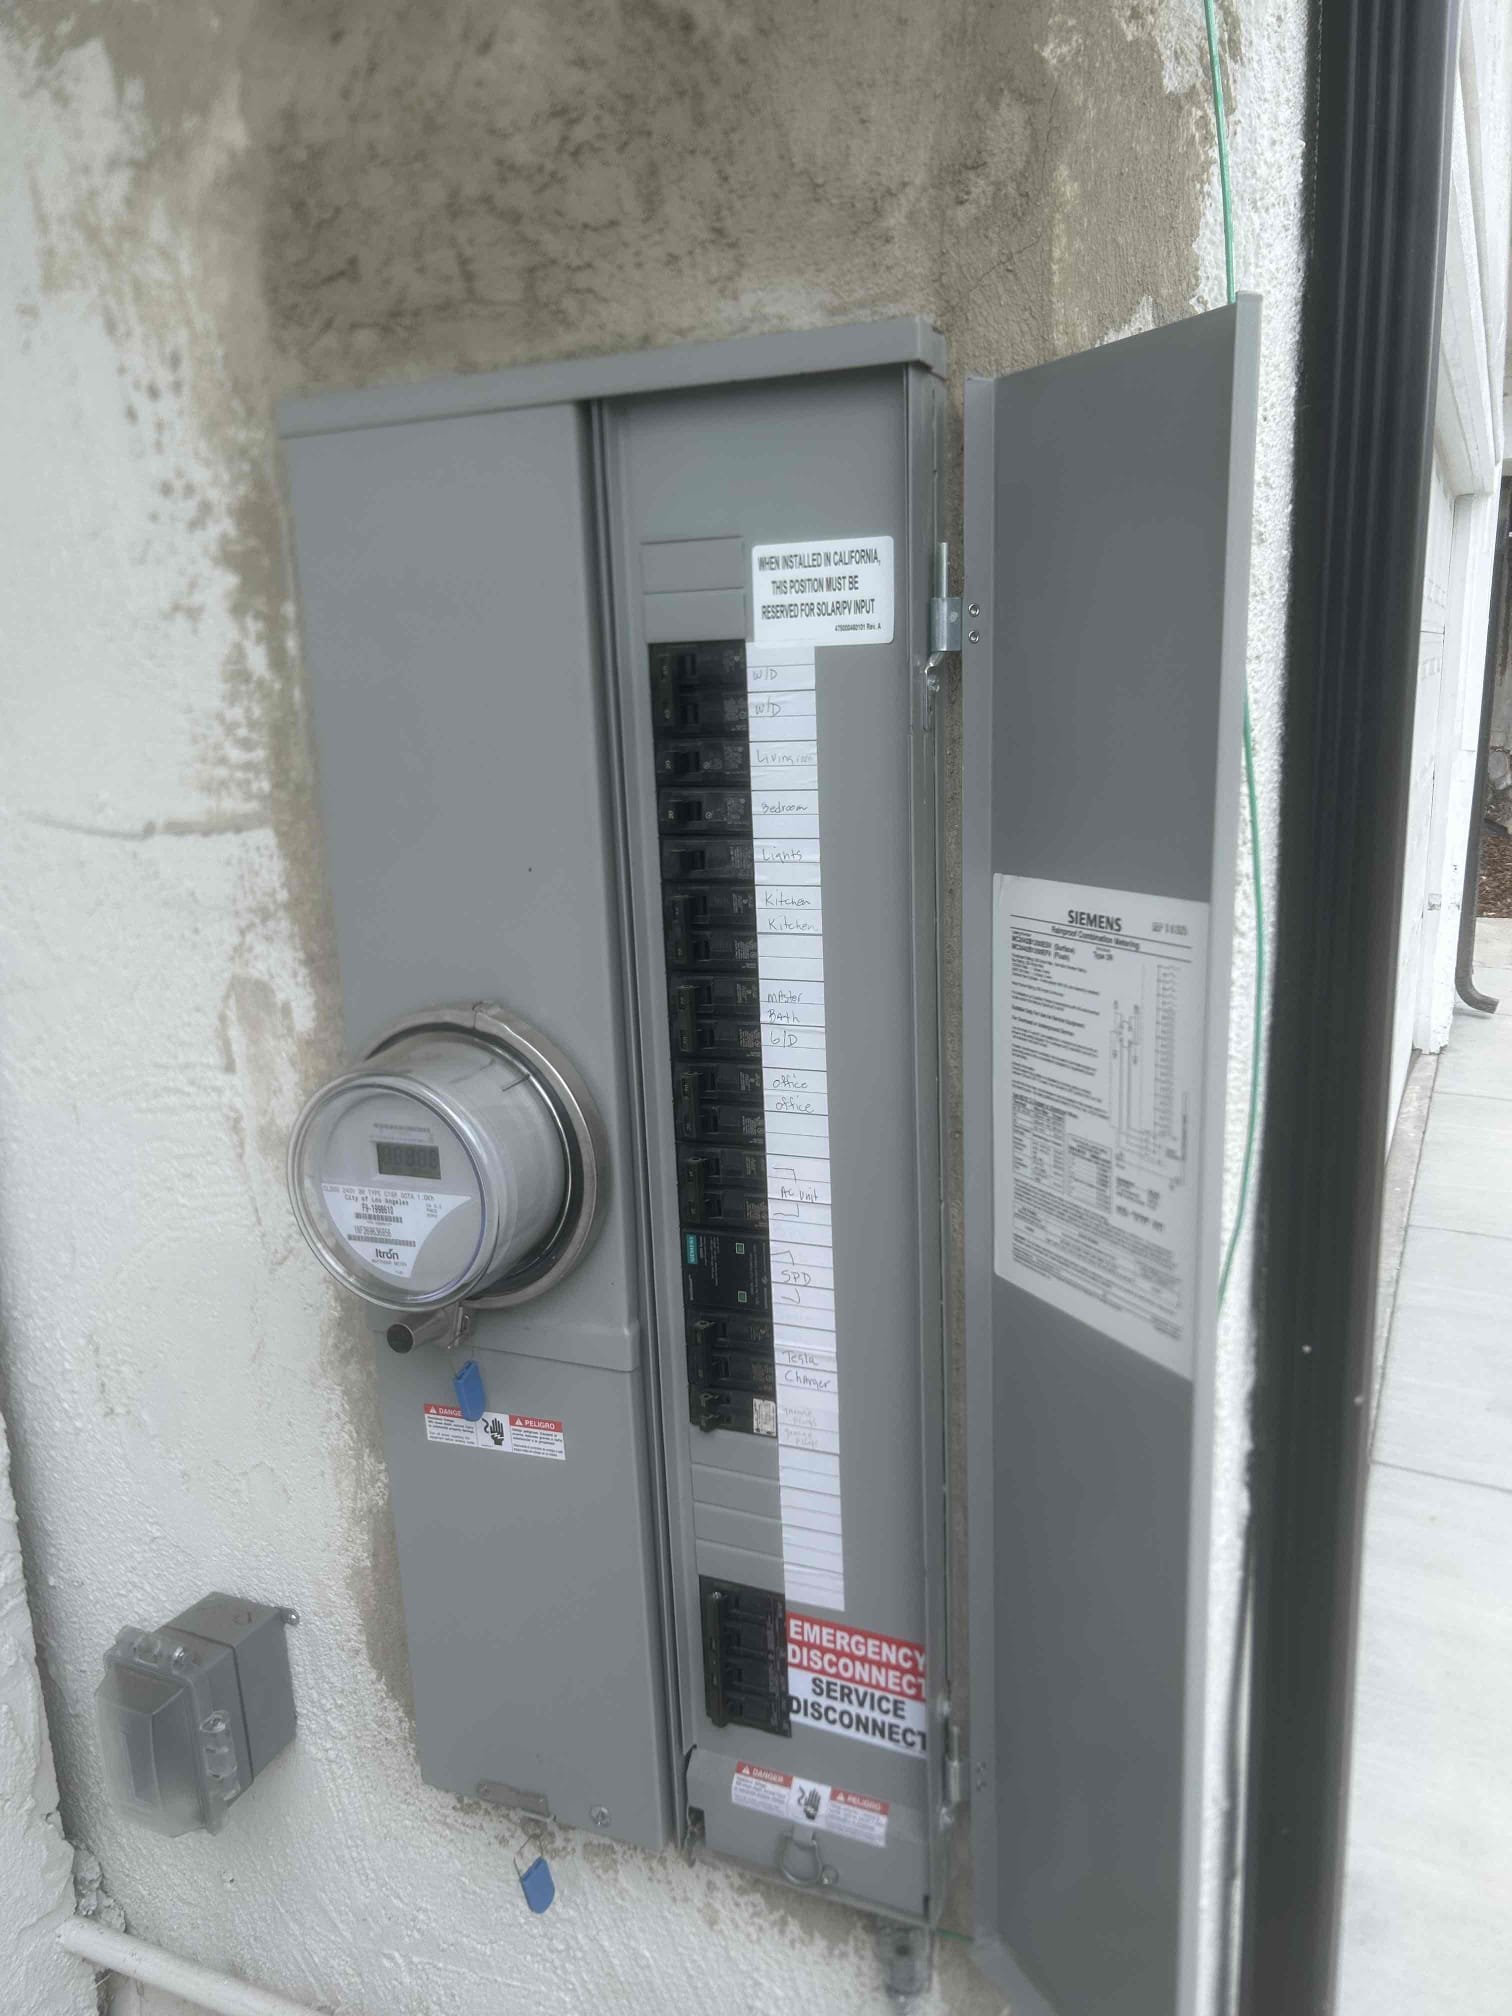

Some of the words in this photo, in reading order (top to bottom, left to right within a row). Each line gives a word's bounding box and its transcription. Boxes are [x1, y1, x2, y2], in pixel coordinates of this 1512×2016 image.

[758, 556, 780, 571] WHEN
[782, 552, 822, 570] INSTALLED
[824, 552, 831, 567] IN
[833, 549, 881, 566] CALIFORNIA,
[771, 580, 788, 595] THIS
[789, 578, 824, 594] POSITION
[825, 576, 846, 592] MUST
[848, 575, 859, 590] BE
[761, 603, 799, 620] RESERVED
[800, 602, 815, 618] FOR
[853, 599, 875, 615] INPUT
[765, 889, 811, 906] Kitchen
[768, 915, 818, 931] Kitchen
[1068, 910, 1122, 932] SIEMENS
[345, 1194, 358, 1202] City
[376, 1248, 399, 1260] Itron
[781, 1270, 811, 1286] SPD
[438, 1407, 463, 1417] DANGE
[524, 1419, 555, 1430] PELIGRO
[789, 1618, 926, 1671] EMERGENCY
[811, 1677, 906, 1720] SERVICE
